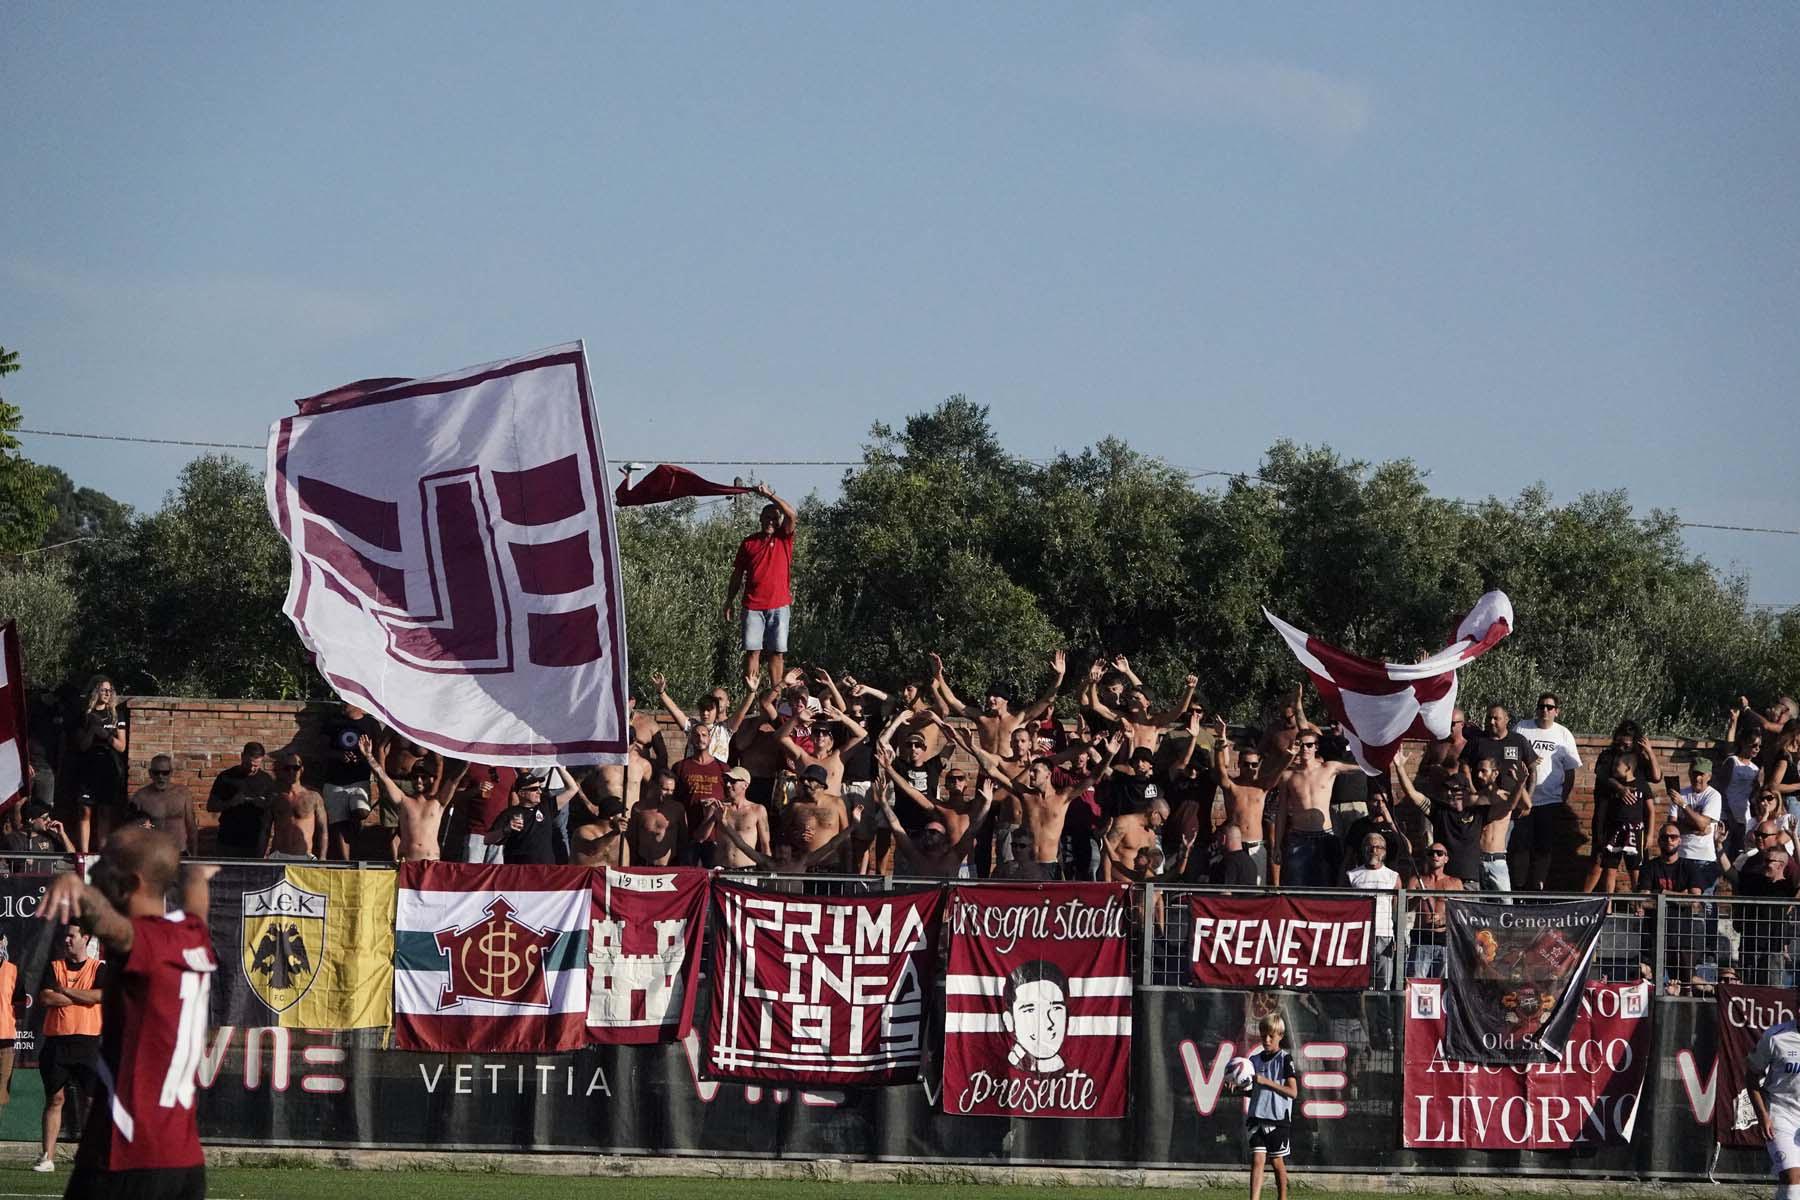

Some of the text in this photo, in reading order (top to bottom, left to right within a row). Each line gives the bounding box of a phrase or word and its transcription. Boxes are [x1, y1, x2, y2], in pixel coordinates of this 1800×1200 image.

[745, 899, 928, 955] PRIMA
[984, 899, 1049, 953] ogni
[1192, 918, 1372, 966] FRENETICI
[1456, 909, 1492, 927] New
[744, 947, 922, 1005] LINEA
[1255, 967, 1309, 987] 1915
[760, 1001, 922, 1055] 1915
[1482, 1033, 1514, 1050] Old
[419, 1063, 612, 1097] VETITIA
[1415, 1094, 1638, 1145] LIVORNO
